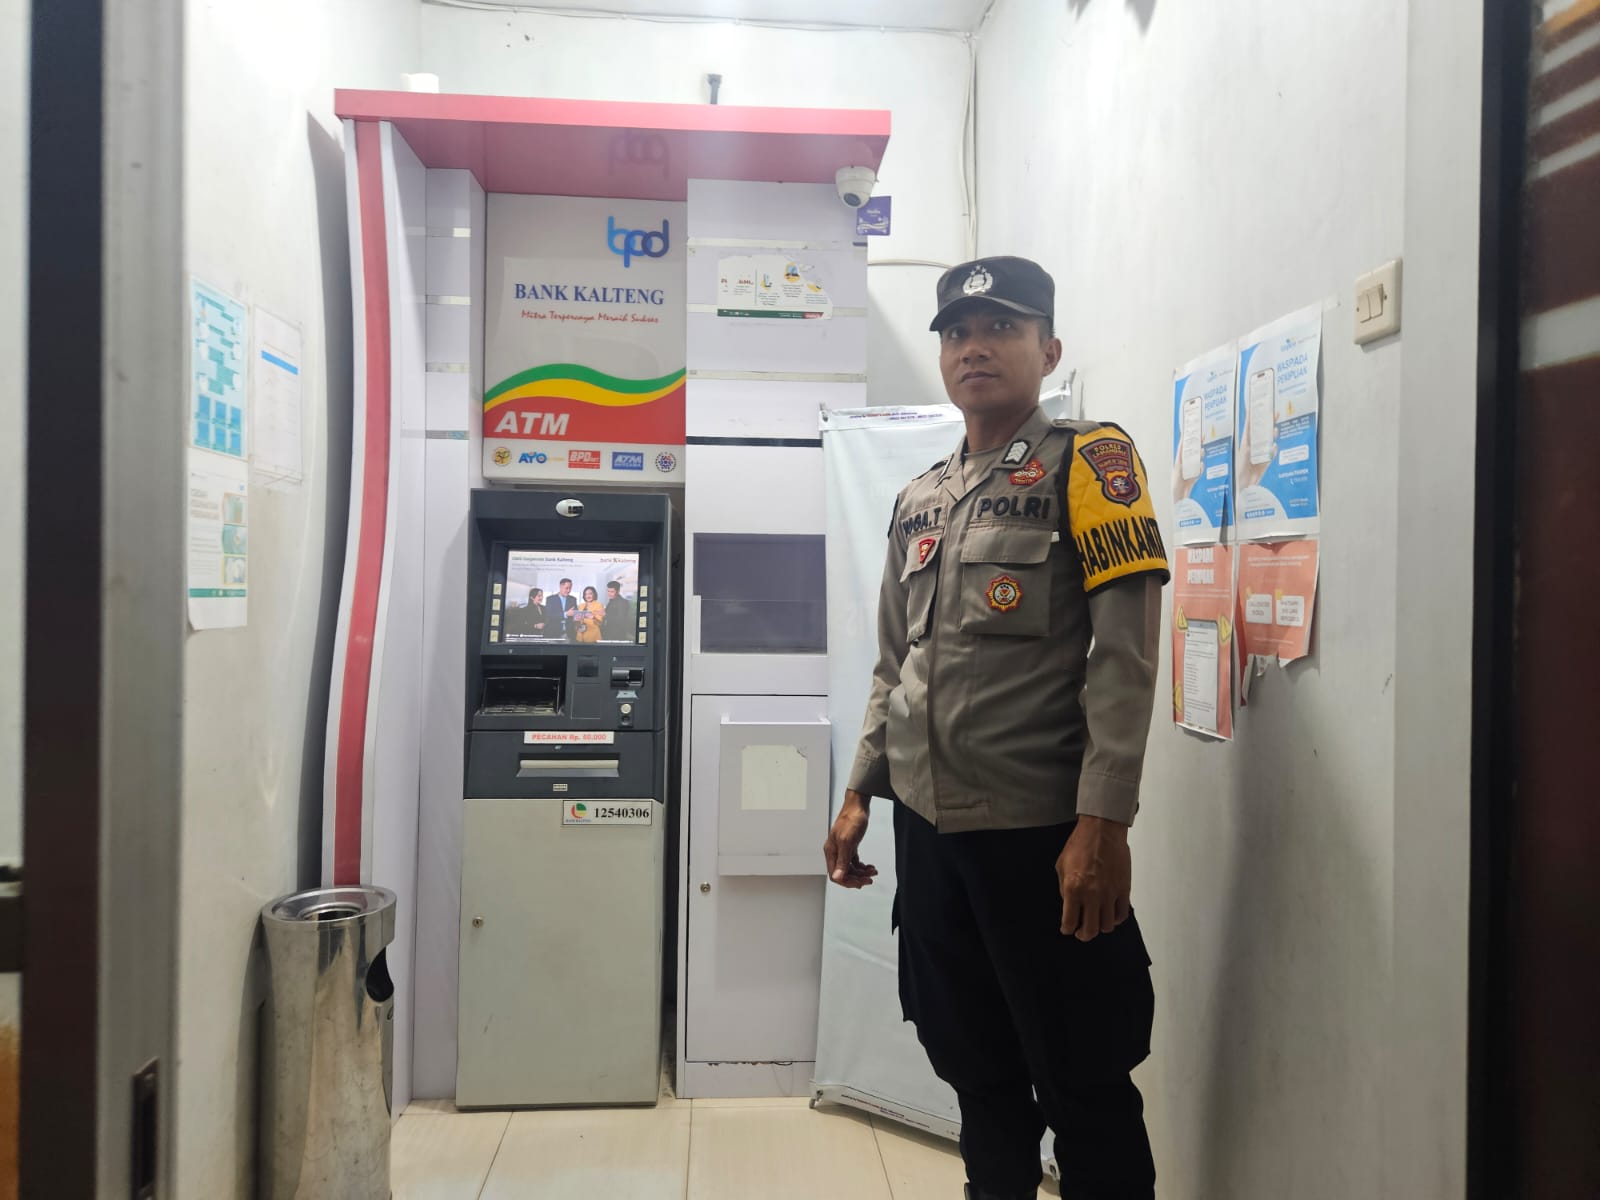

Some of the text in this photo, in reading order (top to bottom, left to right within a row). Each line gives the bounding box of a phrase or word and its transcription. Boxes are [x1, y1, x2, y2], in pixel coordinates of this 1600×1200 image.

[607, 215, 670, 268] bpd
[515, 283, 664, 305] BANK KALTENG
[521, 309, 546, 319] Mitra
[495, 411, 571, 436] ATM
[1093, 443, 1122, 452] POLRES
[518, 452, 548, 464] AYO
[977, 496, 1050, 519] POLRI
[594, 807, 650, 819] 12540306
